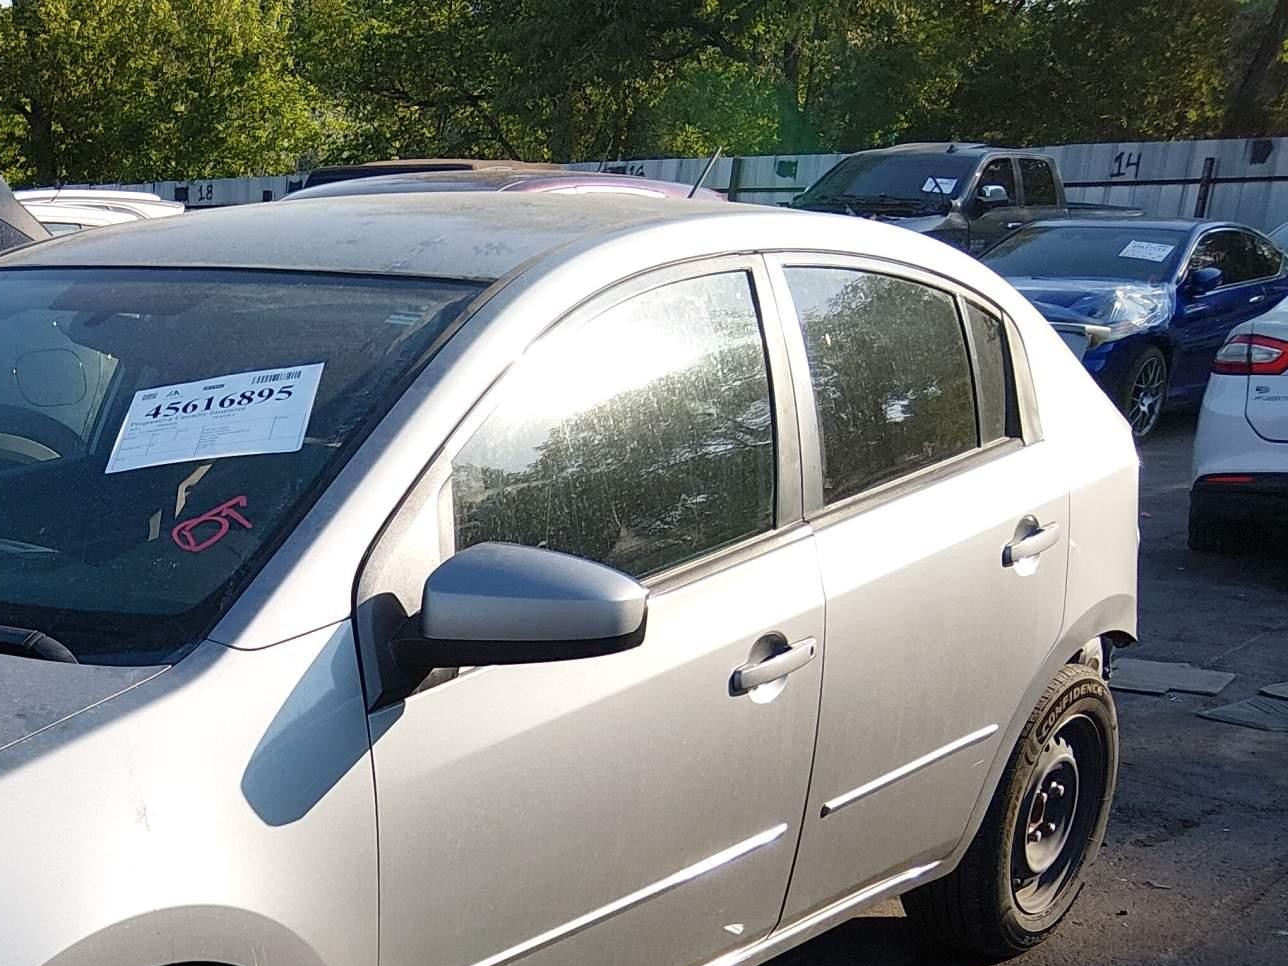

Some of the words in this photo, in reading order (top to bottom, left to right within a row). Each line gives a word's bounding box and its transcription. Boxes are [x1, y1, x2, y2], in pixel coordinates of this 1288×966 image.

[1110, 151, 1142, 179] 14
[198, 184, 213, 201] 18
[145, 384, 295, 418] 45616895
[1041, 682, 1104, 738] CONFIDENCE
